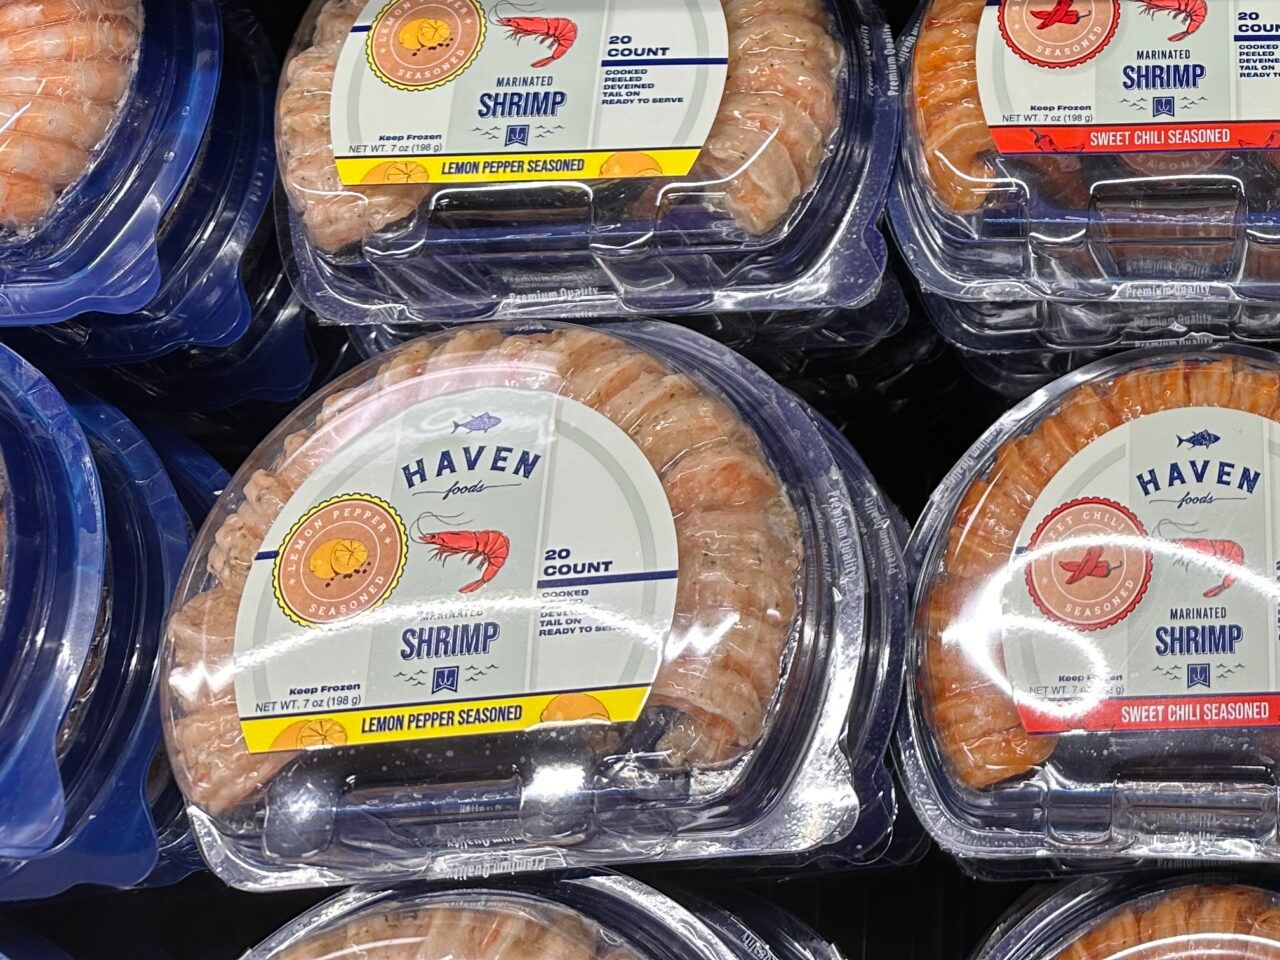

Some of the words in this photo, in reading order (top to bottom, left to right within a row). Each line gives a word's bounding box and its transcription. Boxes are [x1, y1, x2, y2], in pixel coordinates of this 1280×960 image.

[379, 1, 412, 42] LEMON
[1237, 12, 1260, 21] 20
[608, 35, 633, 45] 20
[1036, 26, 1102, 56] SEASONED
[607, 47, 670, 57] COUNT
[1136, 50, 1191, 61] MARINATED
[397, 48, 465, 80] SEASONED
[496, 76, 553, 87] MARINATED
[1122, 63, 1206, 90] SHRIMP
[478, 90, 568, 119] SHRIMP
[1002, 114, 1021, 122] NET
[1023, 114, 1041, 122] WT.
[1063, 114, 1083, 122] (198
[1085, 114, 1093, 123] g)
[1090, 131, 1131, 146] SWEET
[1134, 130, 1165, 145] CHILI
[1168, 128, 1231, 144] SEASONED
[441, 160, 480, 175] LEMON
[482, 159, 525, 174] PEPPER
[527, 158, 585, 173] SEASONED
[401, 445, 542, 489] HAVEN
[1136, 459, 1261, 496] HAVEN
[1083, 511, 1126, 531] CHILI
[288, 519, 323, 572] LEMON
[332, 508, 387, 533] PEPPER
[544, 548, 571, 561] 20
[543, 561, 613, 577] COUNT
[309, 575, 384, 616] SEASONED
[1065, 579, 1134, 616] SEASONED
[1170, 606, 1227, 620] MARINATED
[400, 621, 501, 661] SHRIMP
[1155, 624, 1243, 656] SHRIMP
[289, 687, 318, 696] Keep
[321, 683, 361, 693] Frozen
[361, 714, 404, 734] LEMON
[407, 710, 454, 730] PEPPER
[457, 704, 522, 726] SEASONED
[1121, 705, 1163, 723] SWEET
[1168, 704, 1200, 721] CHILI
[1203, 702, 1269, 720] SEASONED
